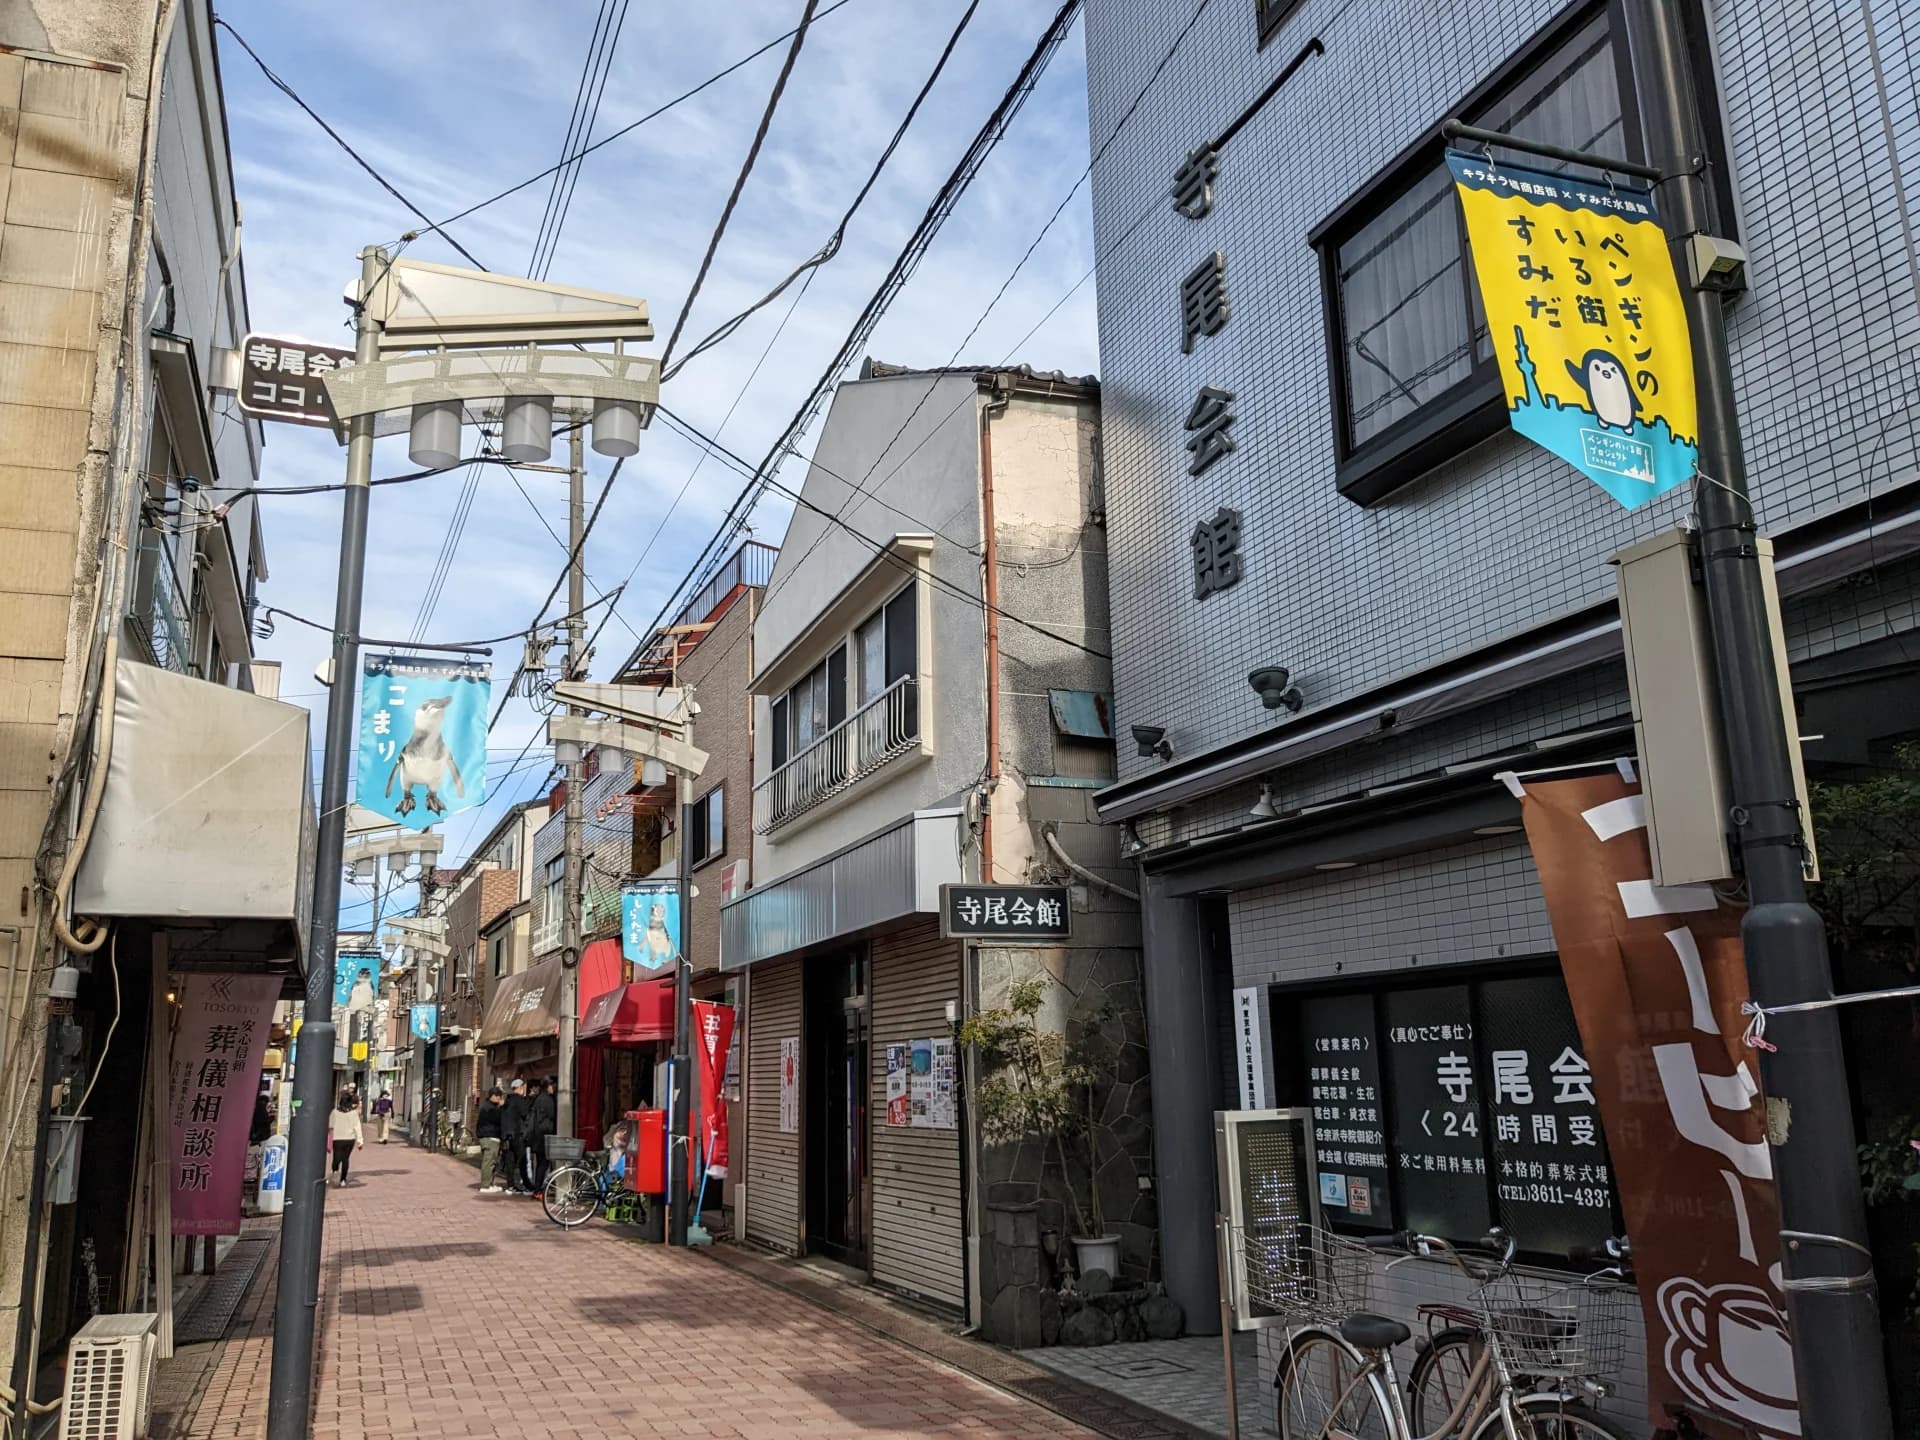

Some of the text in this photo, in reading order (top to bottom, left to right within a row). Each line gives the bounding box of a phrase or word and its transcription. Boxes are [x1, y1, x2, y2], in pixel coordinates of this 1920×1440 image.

[1507, 215, 1562, 328] すみだ
[1600, 233, 1659, 396] ペンギンの
[1172, 139, 1244, 600] 寺尾会館
[373, 685, 407, 762] こまり
[630, 899, 642, 944] しらたま
[956, 896, 1062, 926] 寺尾会館
[178, 1024, 240, 1191] 葬儀相談所
